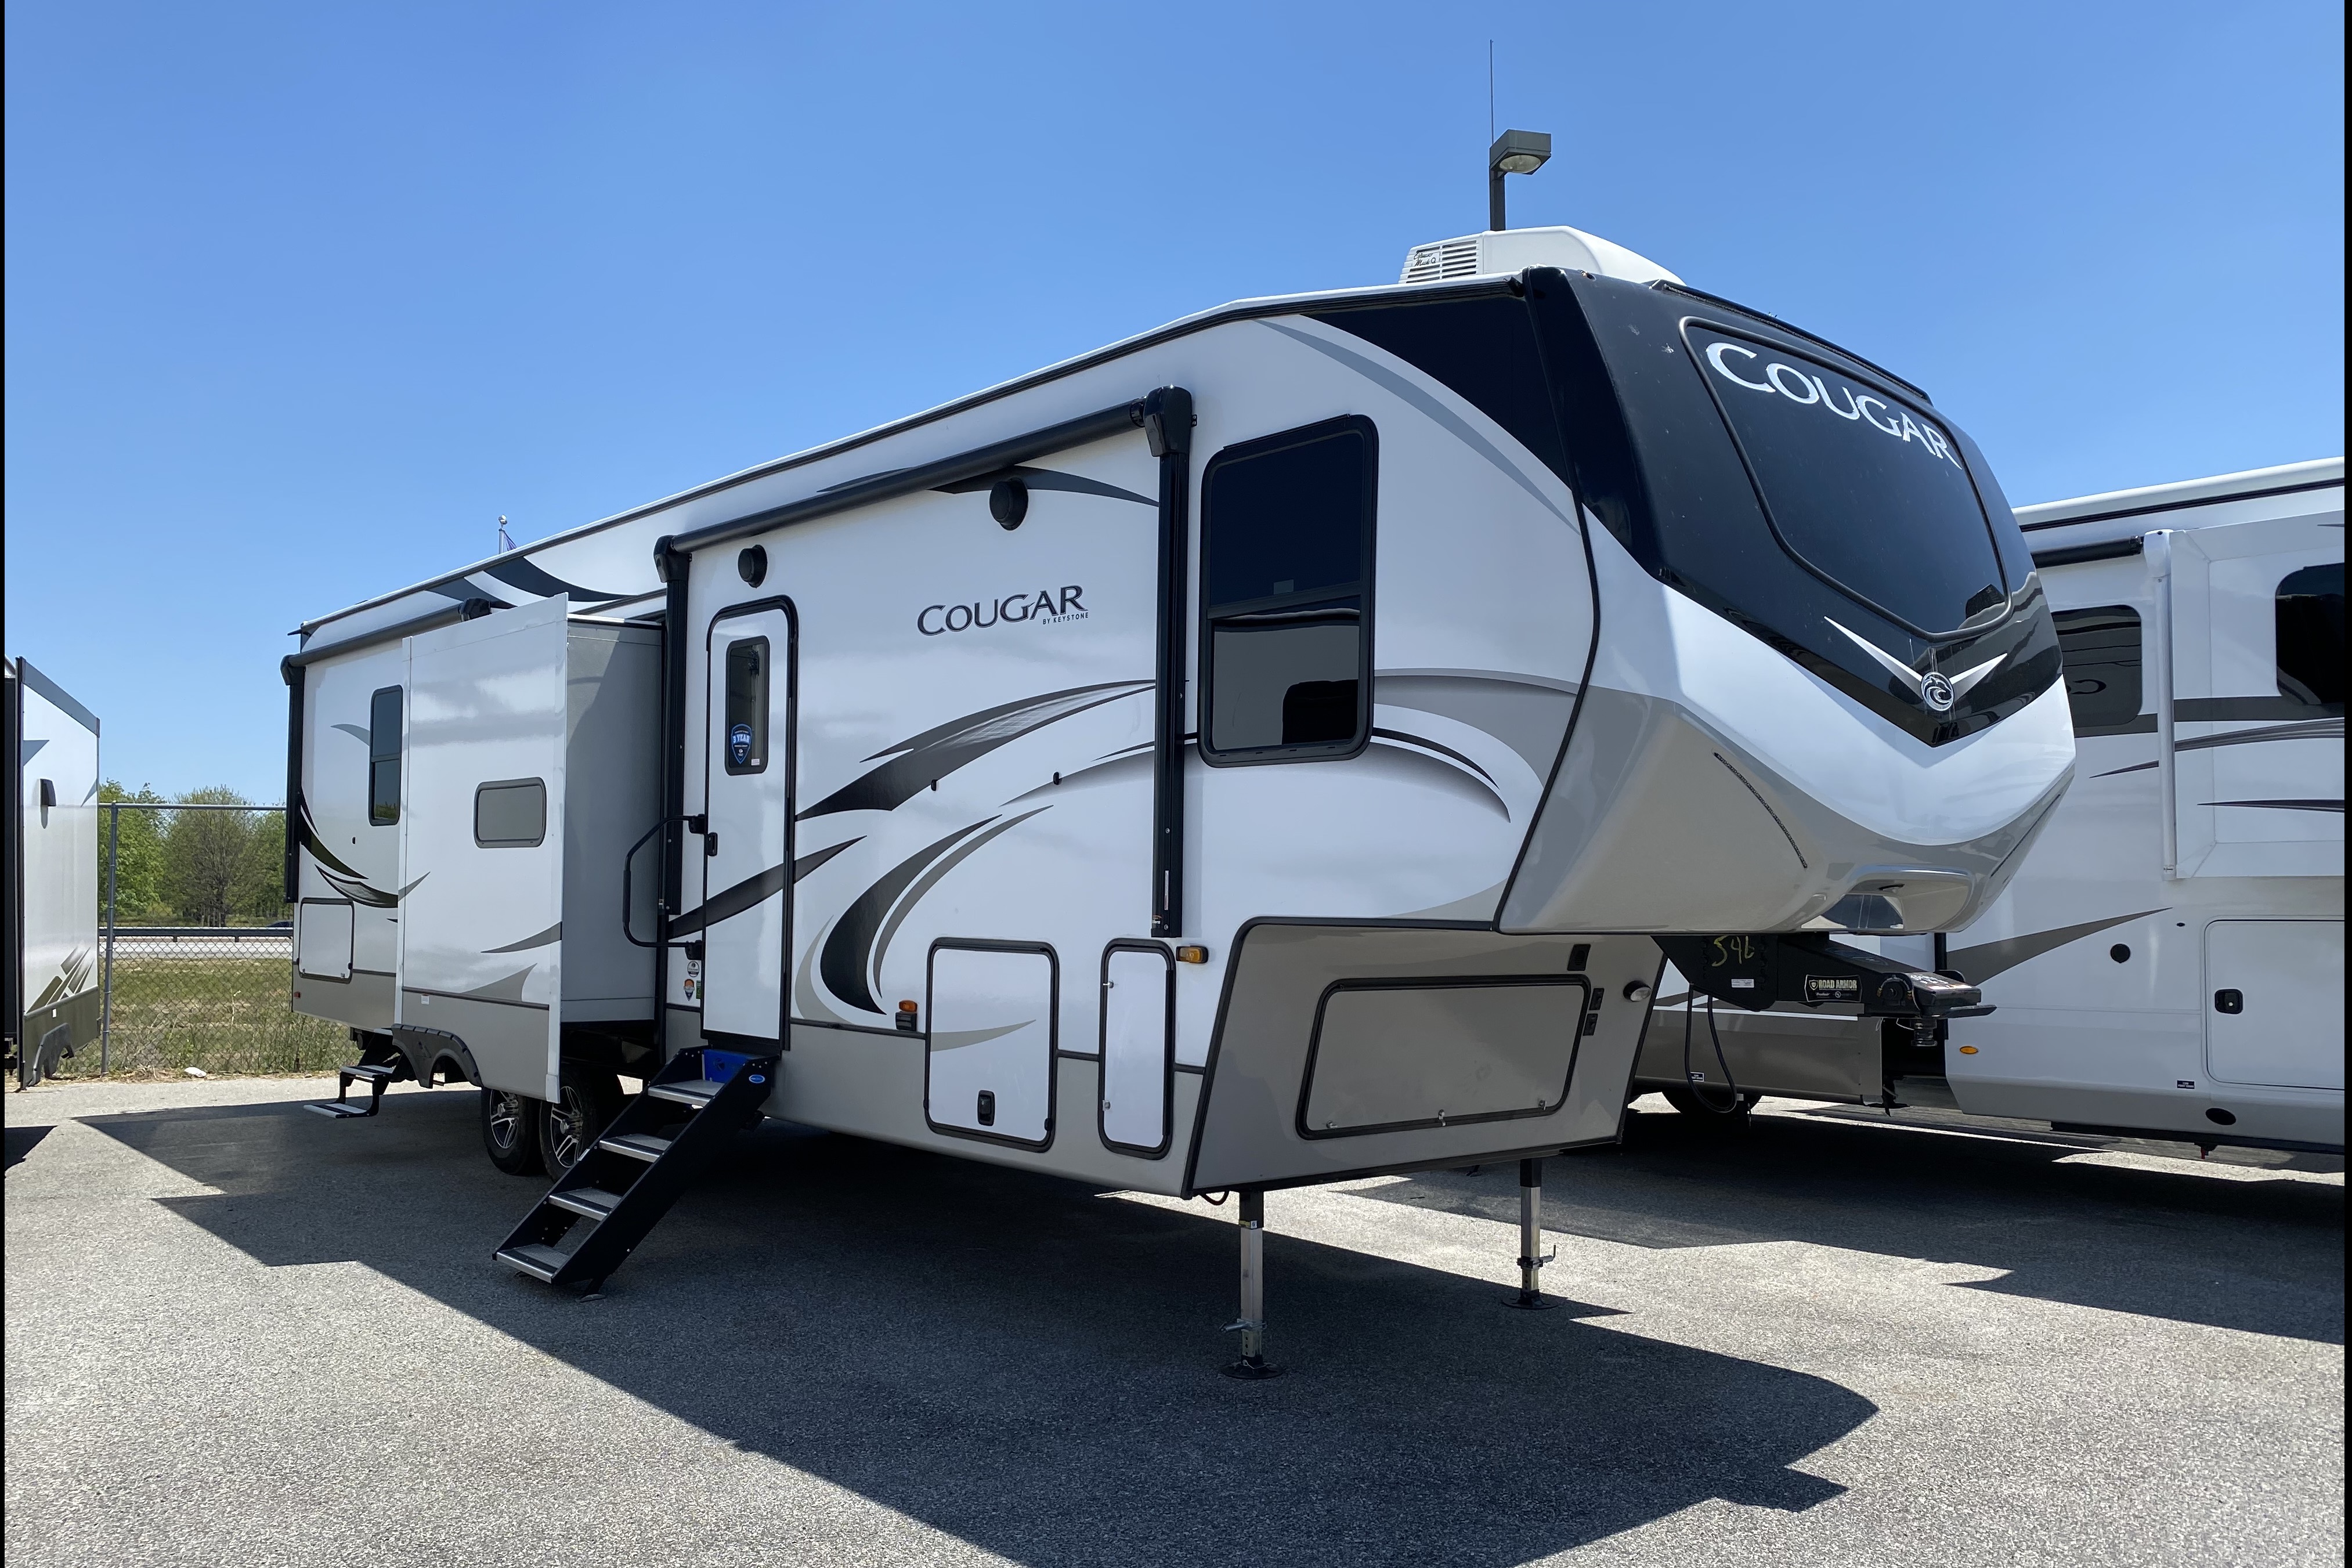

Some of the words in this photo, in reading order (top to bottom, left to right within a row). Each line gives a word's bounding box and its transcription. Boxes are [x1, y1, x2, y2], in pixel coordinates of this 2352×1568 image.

[1705, 342, 1963, 470] COUGAR
[916, 584, 1089, 637] COUGAR
[1053, 612, 1089, 623] KEYSTONE
[736, 734, 750, 743] YEAR
[1819, 980, 1834, 989] ROAD
[1836, 980, 1857, 989] ARMOR
